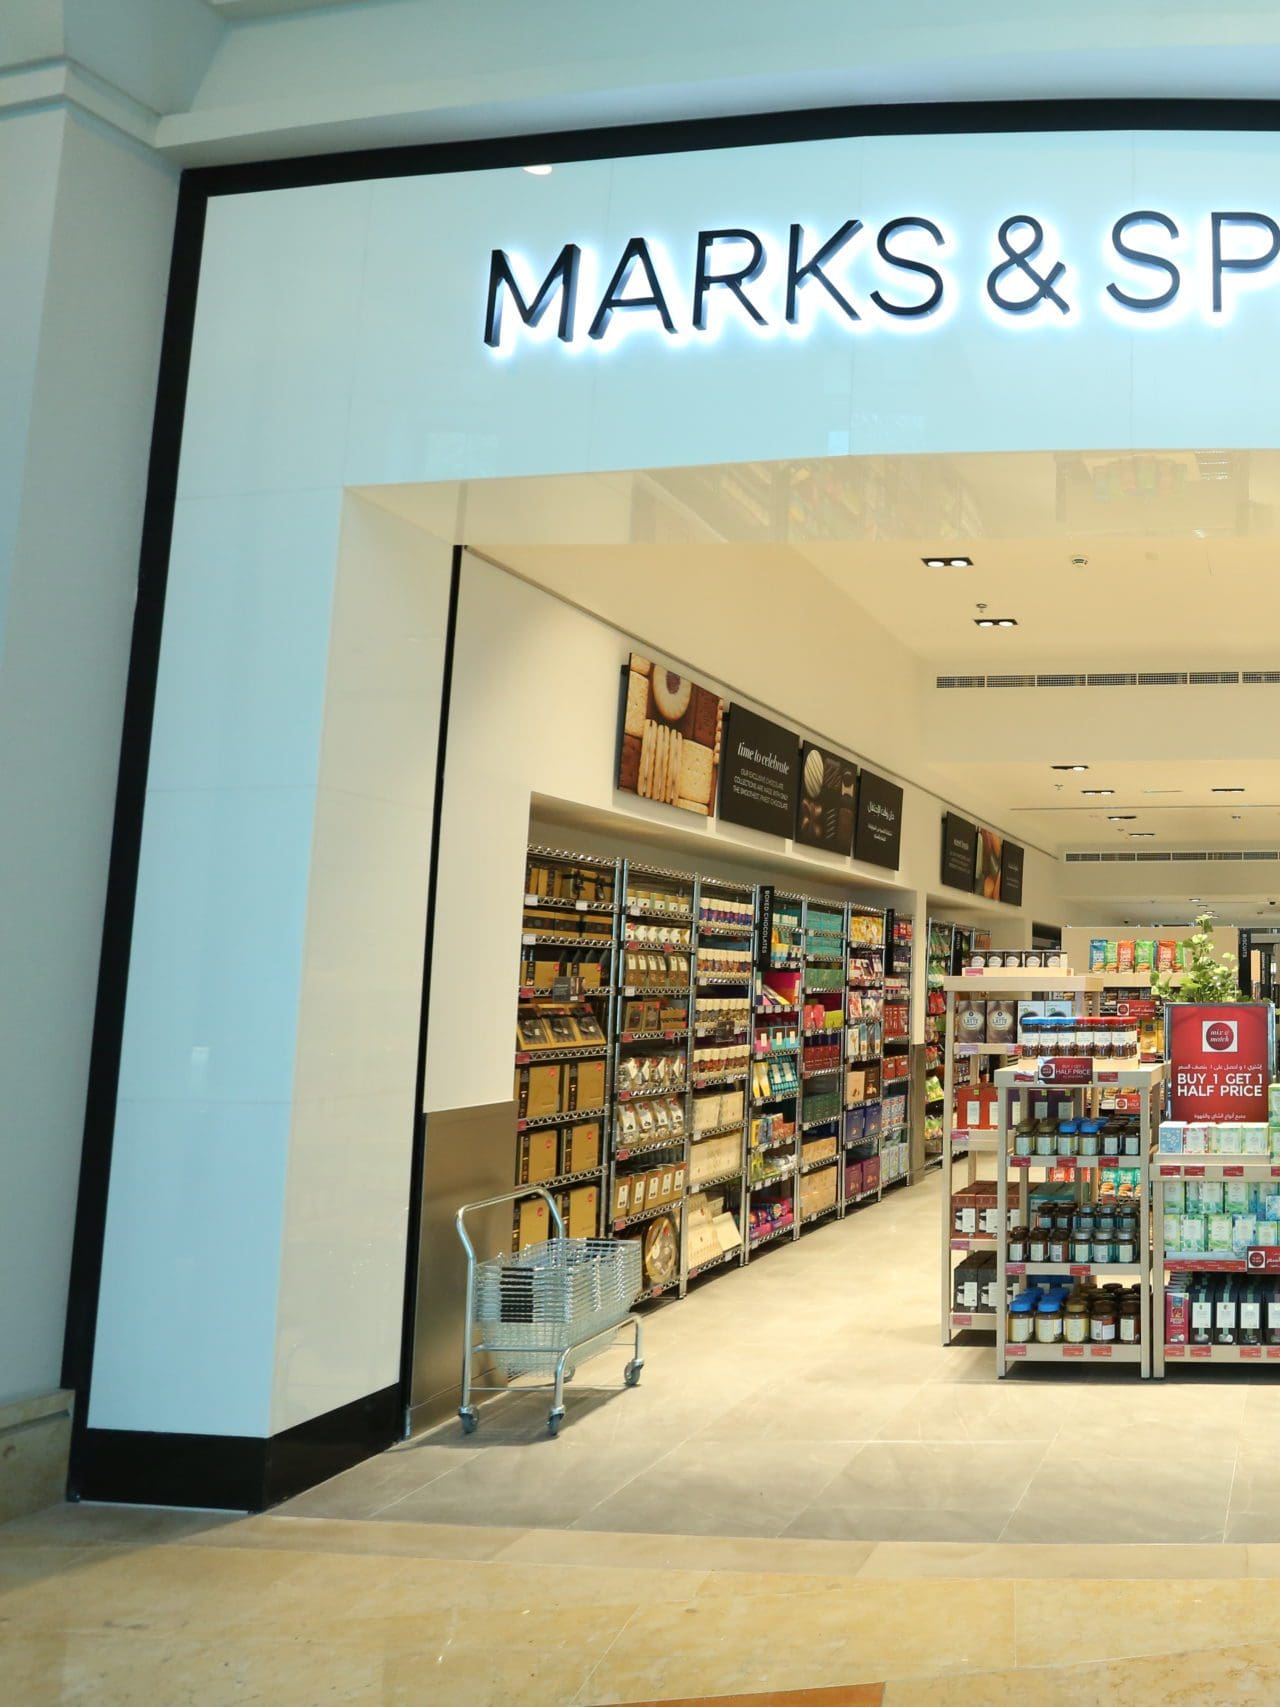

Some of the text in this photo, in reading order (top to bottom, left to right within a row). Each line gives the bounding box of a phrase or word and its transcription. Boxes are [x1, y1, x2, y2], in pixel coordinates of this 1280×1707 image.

[484, 217, 943, 347] MARKS
[988, 213, 1070, 312] &
[737, 741, 790, 776] time to celebrate
[1073, 1068, 1091, 1076] PRICE
[1177, 1073, 1263, 1084] BUY 1 GET 1
[1177, 1085, 1262, 1097] HALF PRICE
